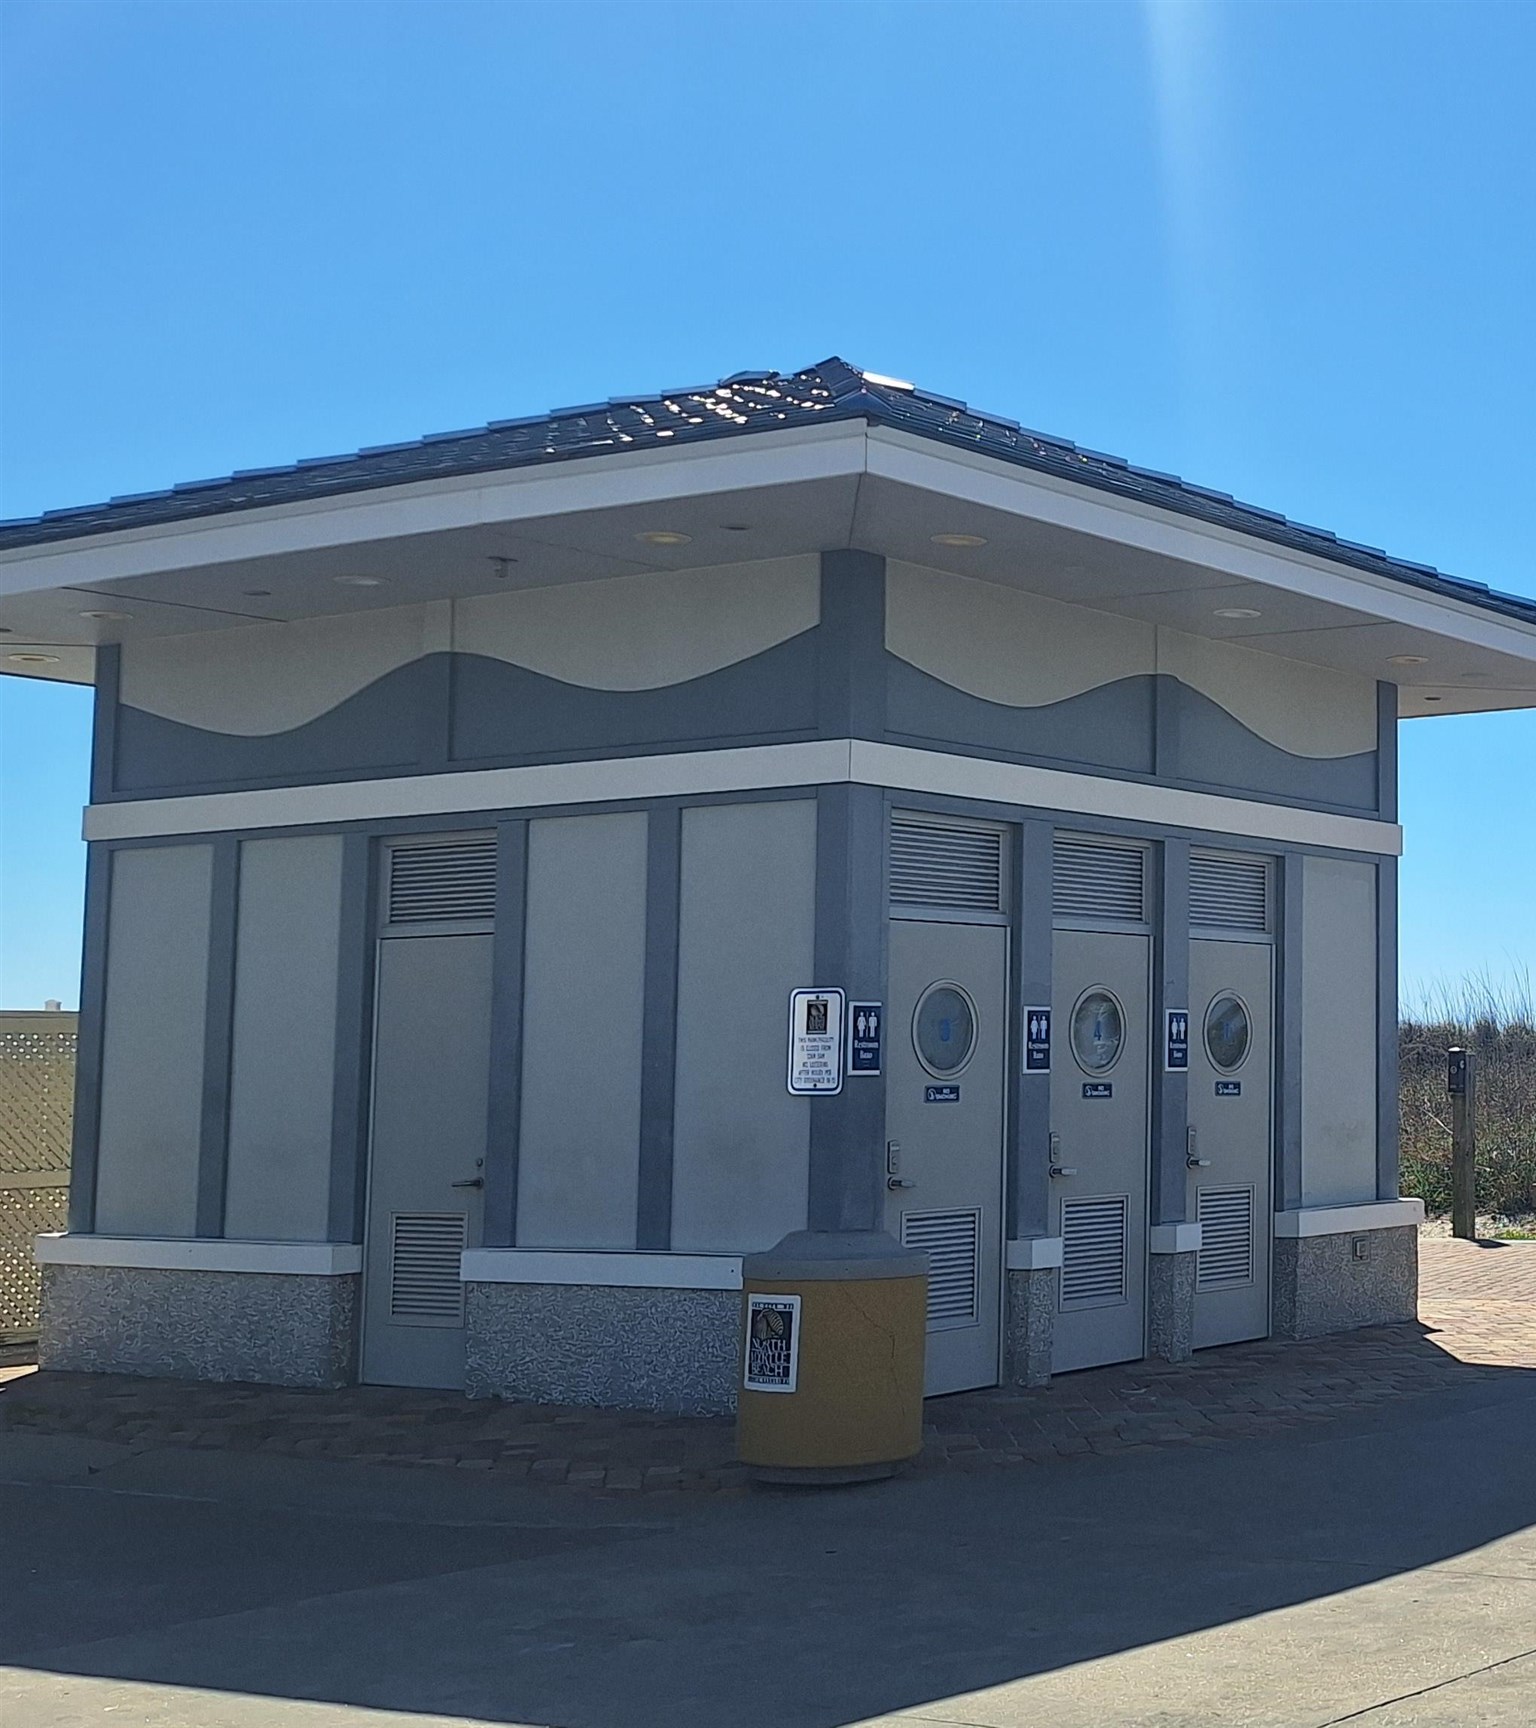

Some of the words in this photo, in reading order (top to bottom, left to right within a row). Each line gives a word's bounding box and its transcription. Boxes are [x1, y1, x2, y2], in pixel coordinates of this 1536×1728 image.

[752, 1337, 787, 1352] NORTH
[750, 1351, 789, 1365] MYRTLE
[751, 1363, 784, 1377] BEACH
